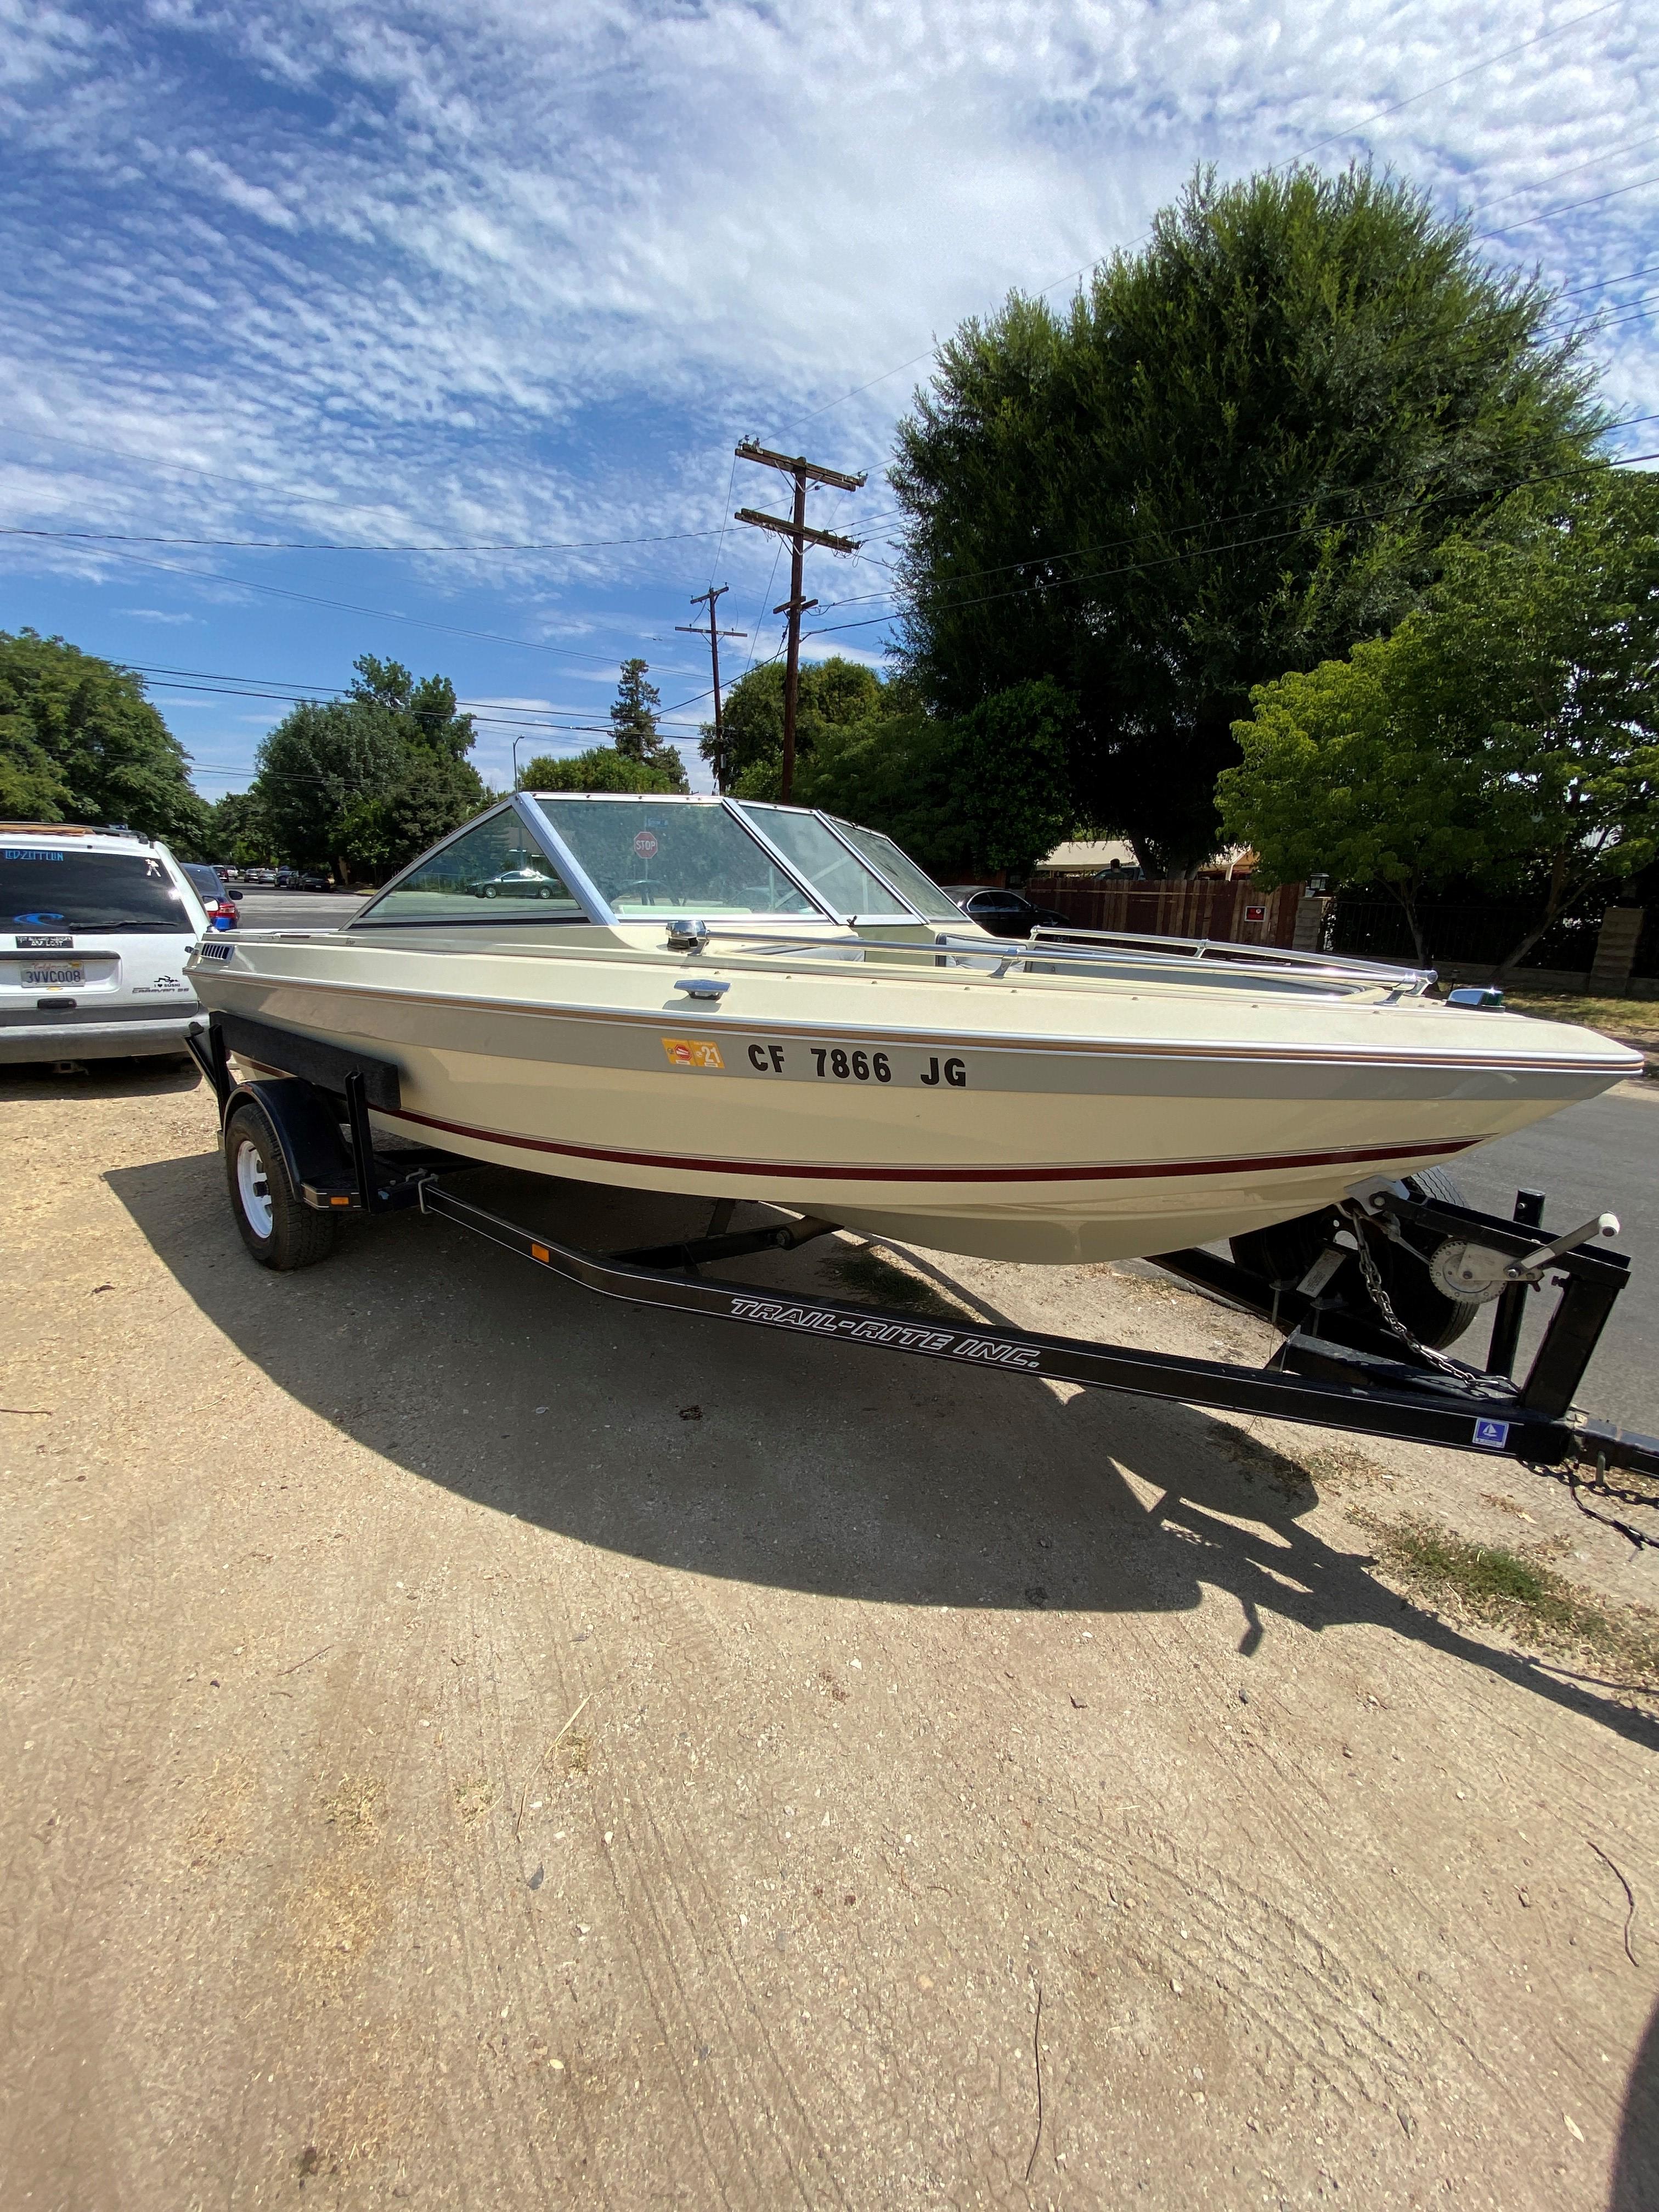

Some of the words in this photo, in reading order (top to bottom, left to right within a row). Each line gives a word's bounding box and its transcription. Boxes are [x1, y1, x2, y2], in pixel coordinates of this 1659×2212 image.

[636, 840, 656, 850] STOP
[26, 970, 81, 983] 3VVC008
[702, 1046, 721, 1063] 21
[748, 1044, 785, 1073] CF
[810, 1048, 891, 1082] 7866
[921, 1057, 966, 1086] JG
[731, 1298, 955, 1350] TRAIL-RITE
[952, 1339, 1041, 1368] INC.
